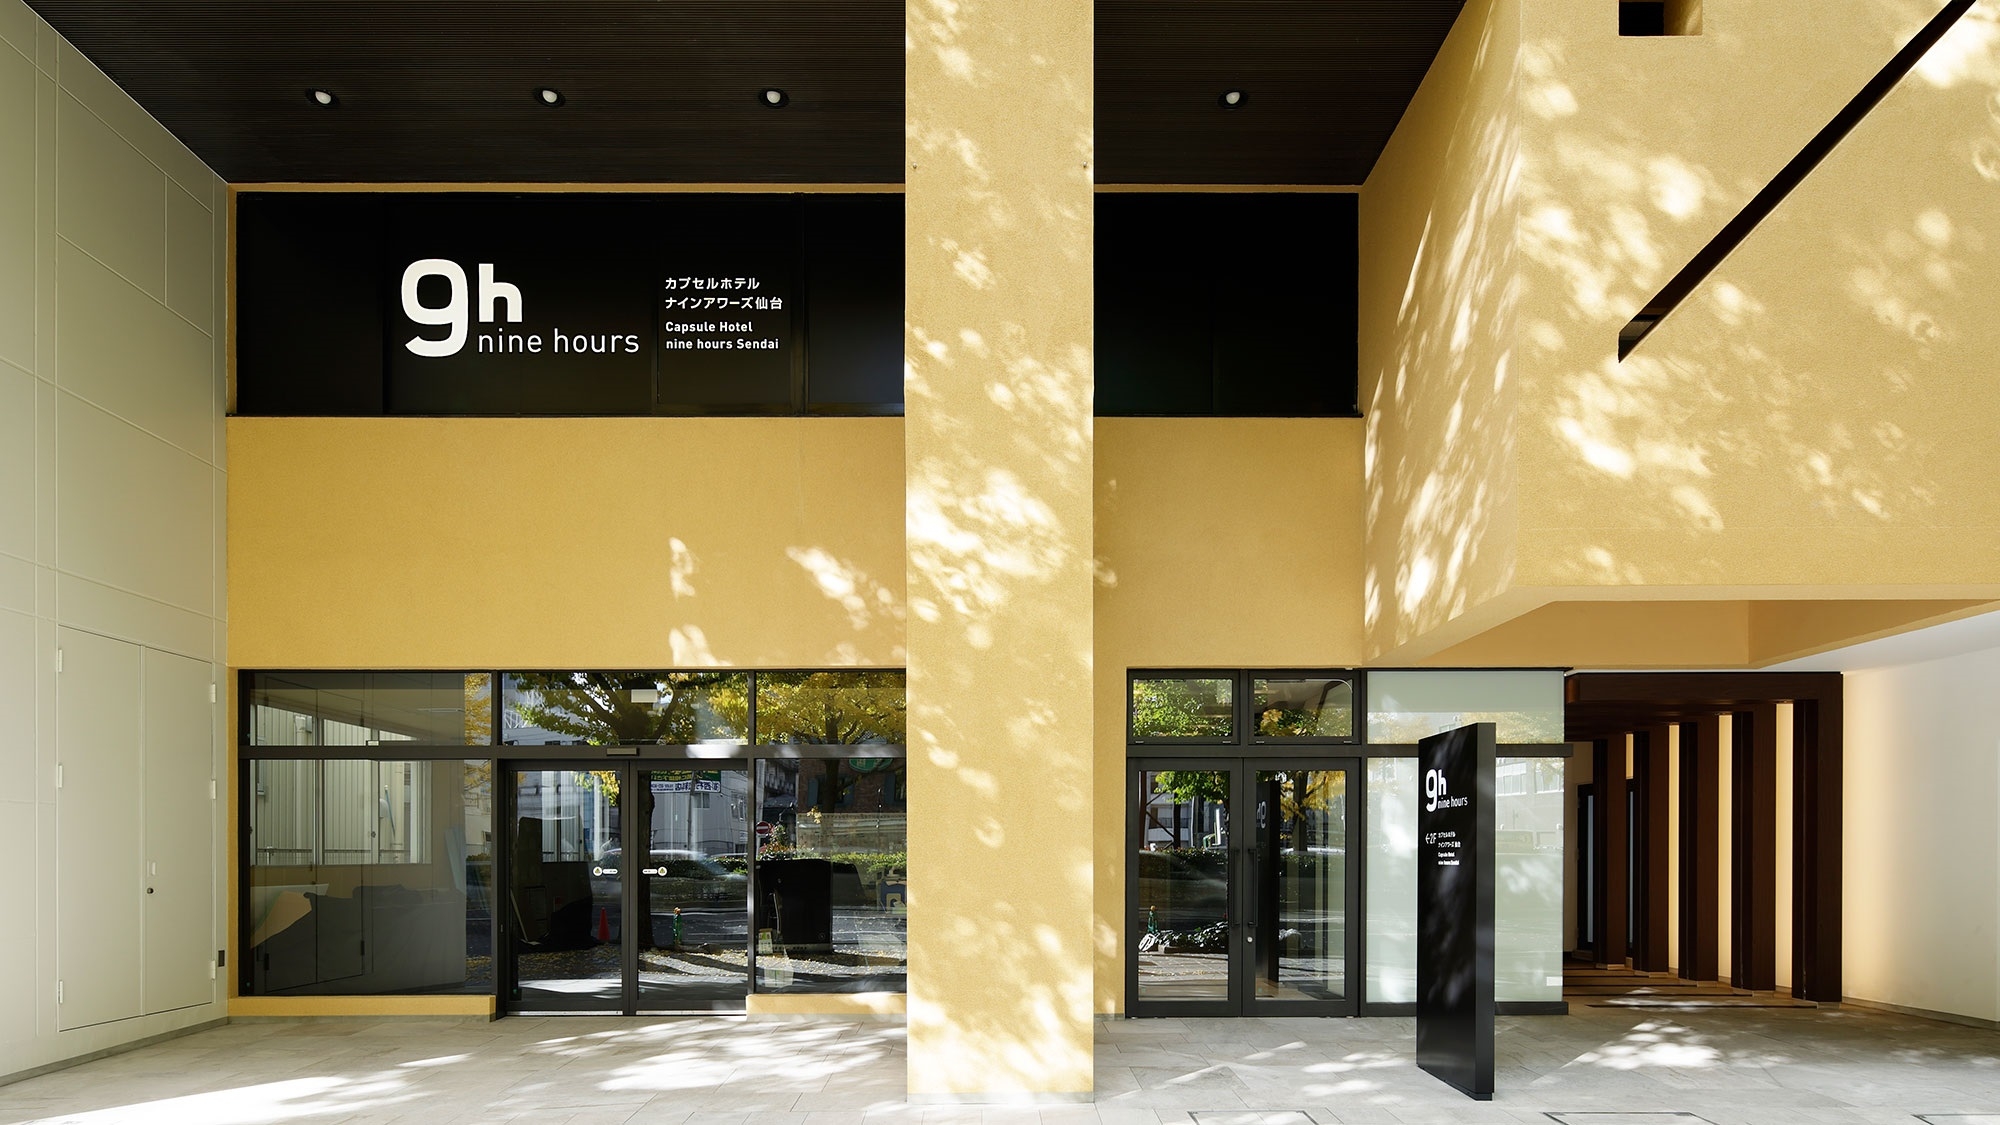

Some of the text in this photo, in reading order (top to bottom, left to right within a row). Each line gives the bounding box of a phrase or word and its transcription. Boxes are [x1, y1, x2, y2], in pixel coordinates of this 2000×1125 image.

[665, 277, 760, 290] カプセルホテル
[665, 297, 783, 310] ナインアワーズ仙台
[665, 322, 753, 334] Capsule Hotel
[478, 328, 640, 353] nine hours
[666, 339, 779, 350] nine hours Sendai
[1438, 796, 1468, 809] nine hours
